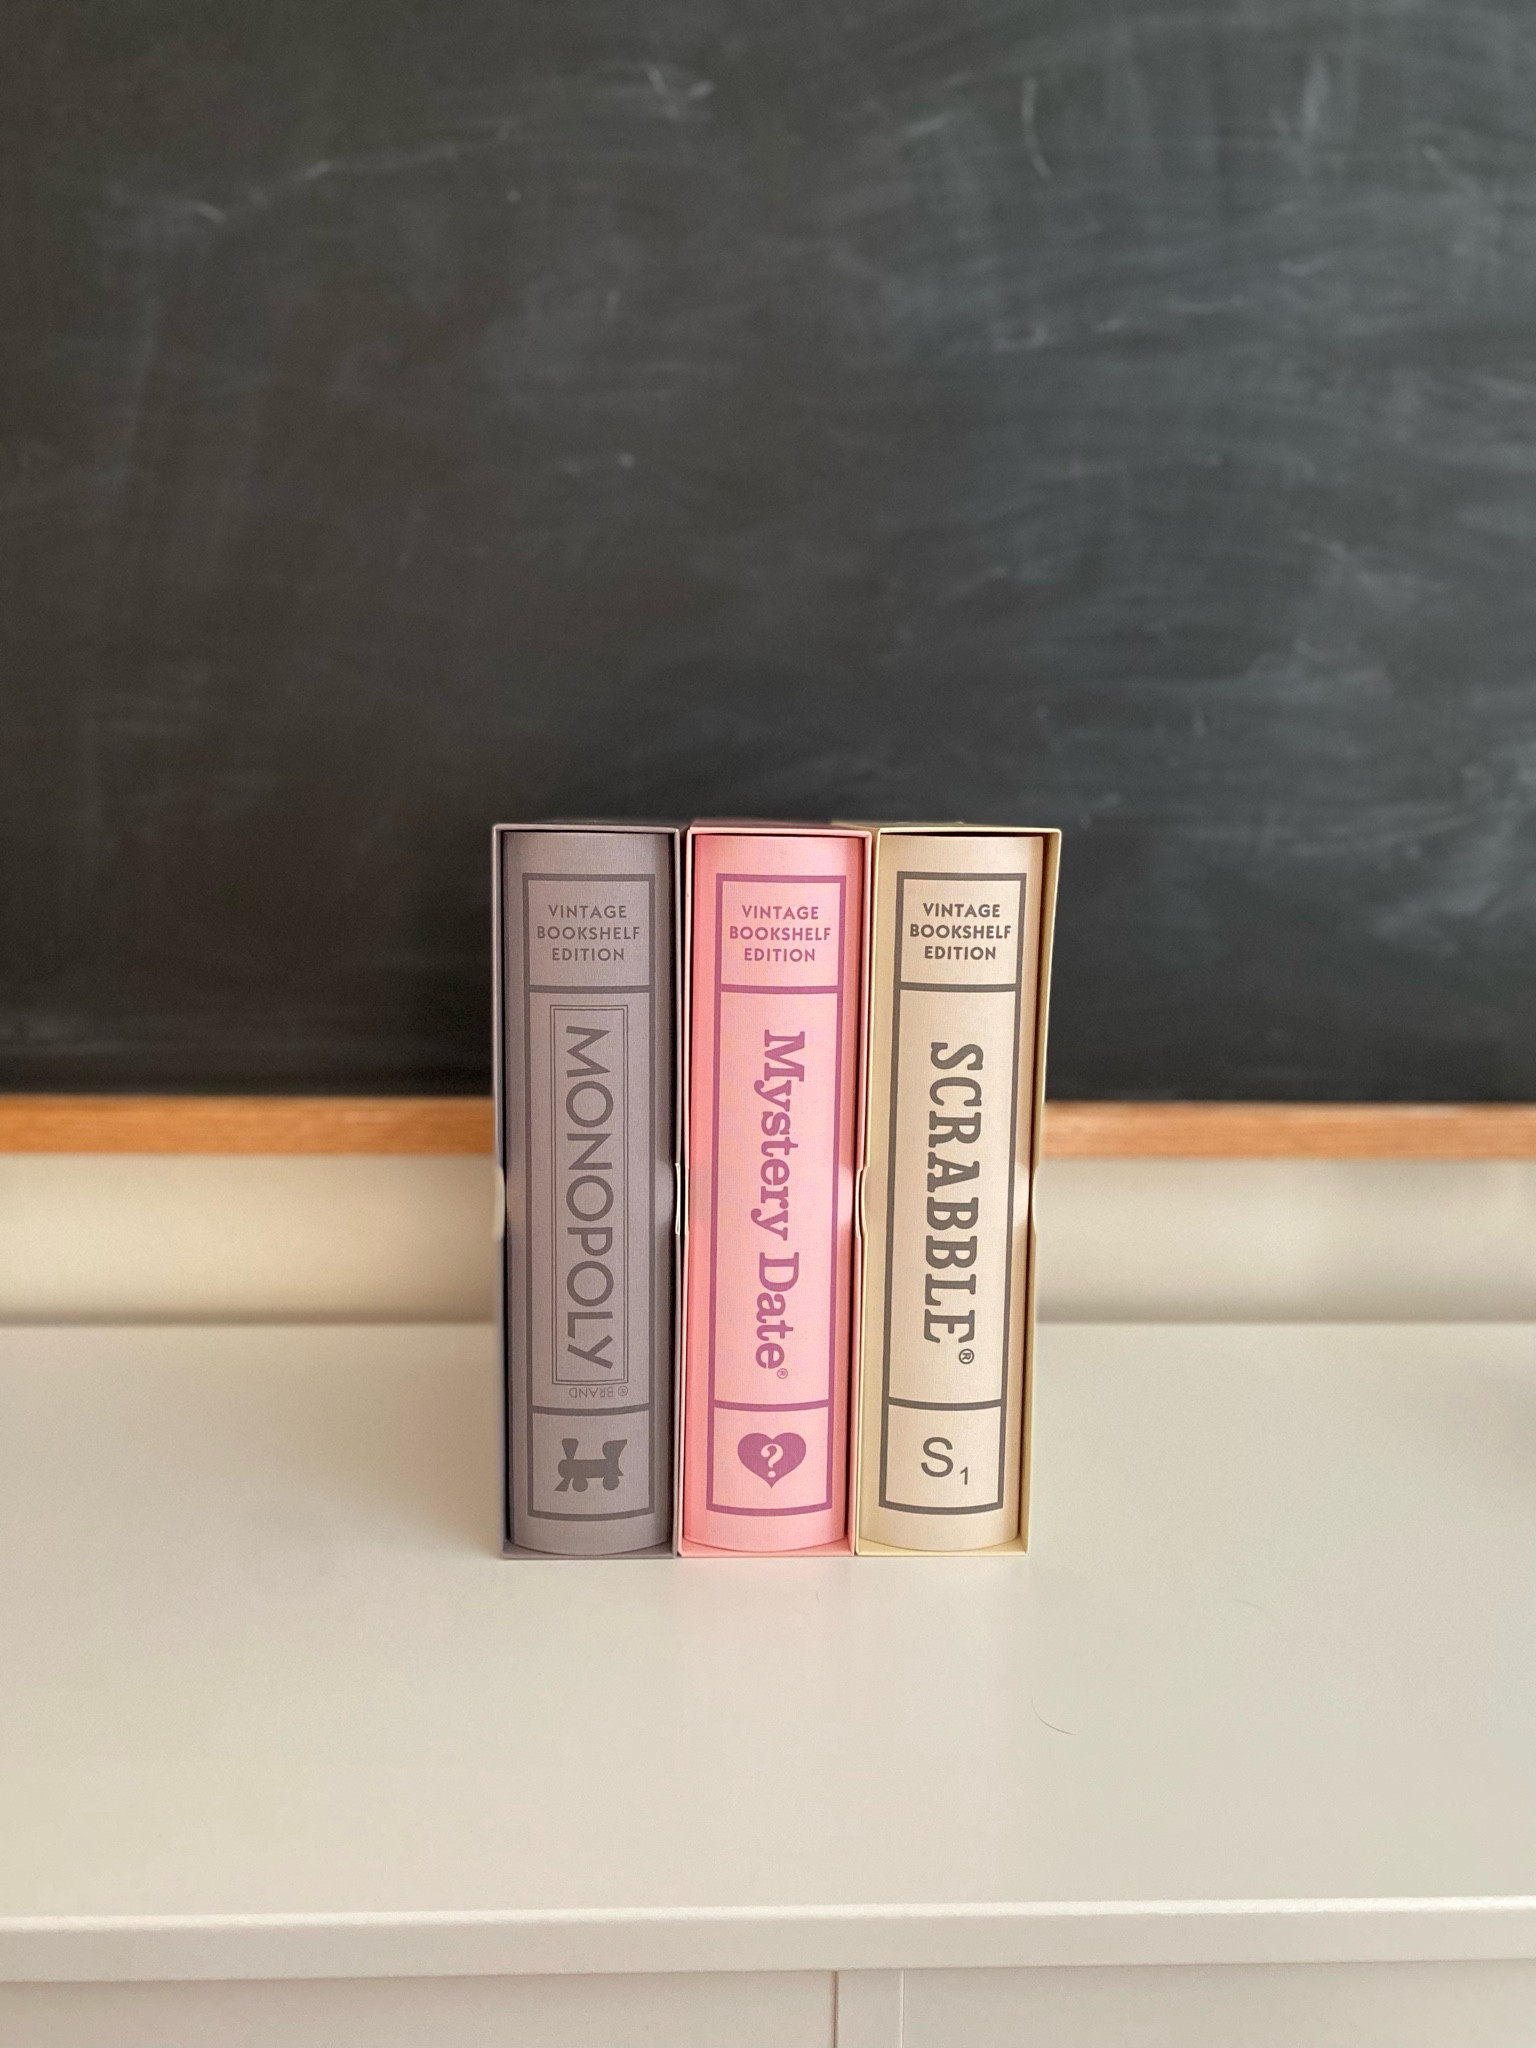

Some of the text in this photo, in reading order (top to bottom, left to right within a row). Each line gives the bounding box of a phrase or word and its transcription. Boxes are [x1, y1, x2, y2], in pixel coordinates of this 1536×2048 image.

[547, 904, 628, 919] VINTAGE
[741, 904, 820, 921] VINTAGE
[922, 902, 1001, 919] VINTAGE
[536, 924, 641, 941] BOOKSHELF
[729, 924, 832, 942] BOOKSHELF
[909, 923, 1012, 940] BOOKSHELF
[551, 947, 625, 962] EDITION
[744, 947, 816, 963] EDITION
[924, 945, 997, 961] EDITION
[750, 1028, 806, 1242] Mystery
[565, 1025, 615, 1370] MONOPOLY
[568, 1386, 614, 1398] BRAND
